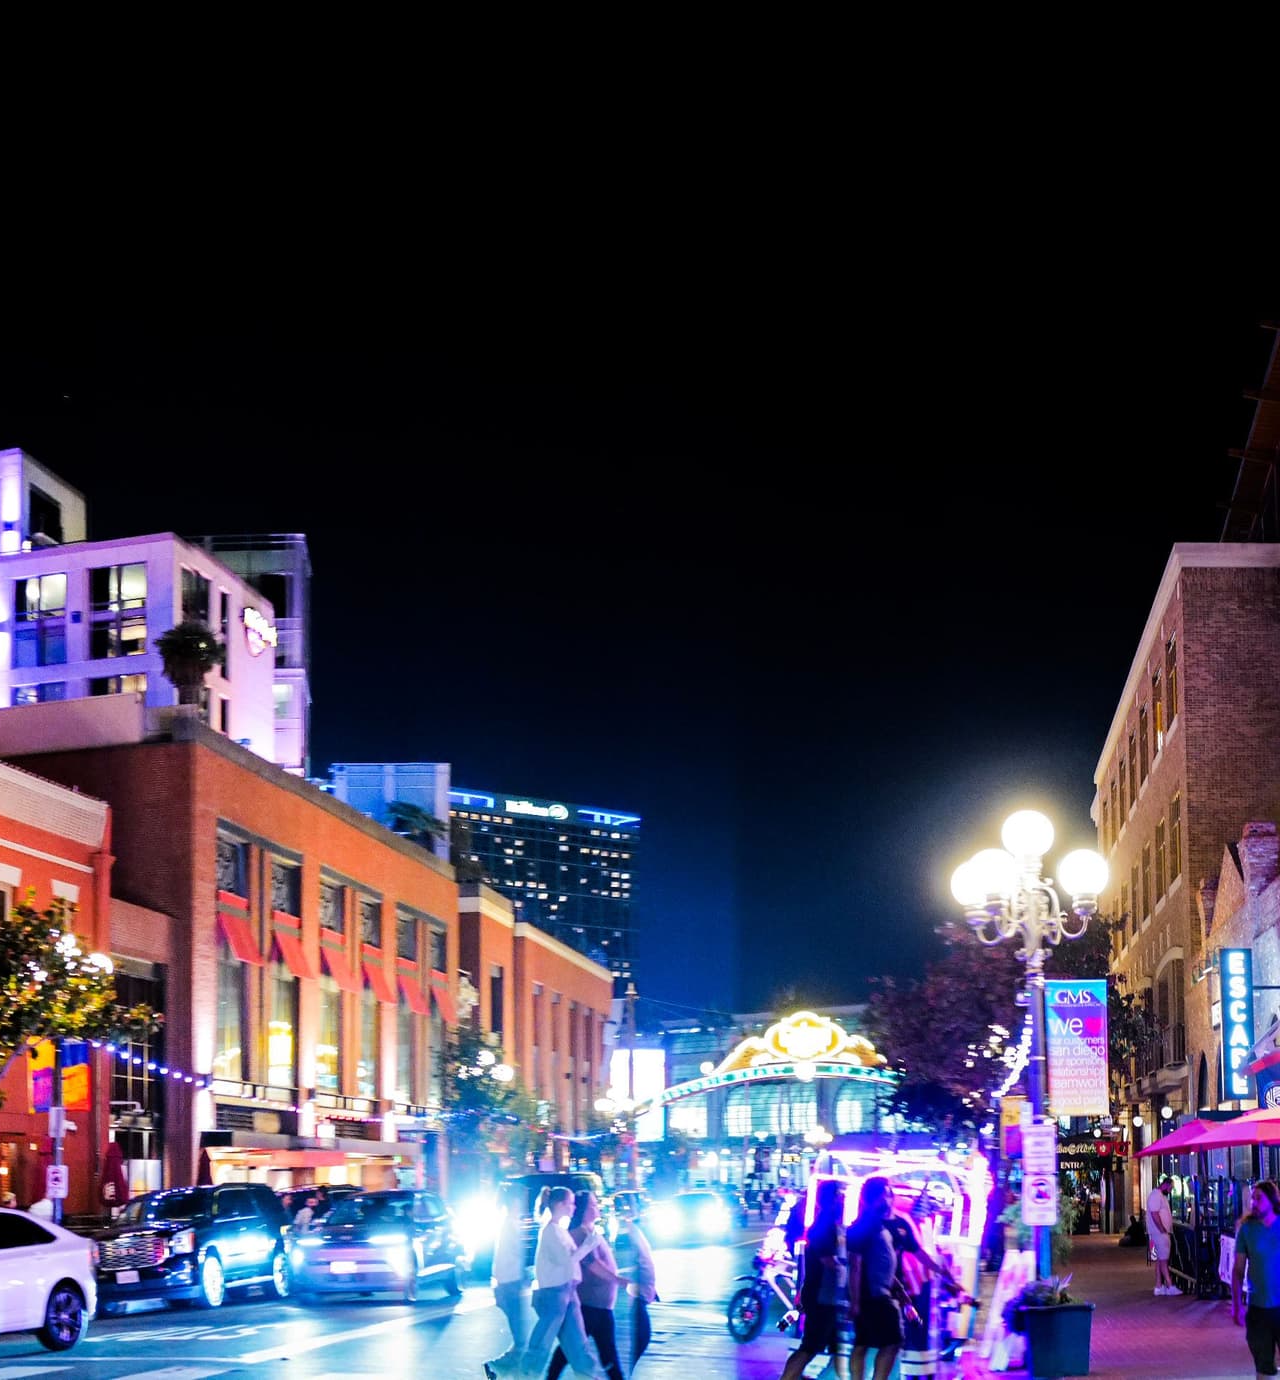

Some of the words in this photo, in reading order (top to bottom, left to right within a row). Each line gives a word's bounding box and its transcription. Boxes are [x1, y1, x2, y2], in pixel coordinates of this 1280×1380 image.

[1055, 989, 1091, 1004] GMS
[1048, 1017, 1083, 1036] we
[1072, 1044, 1105, 1057] diego
